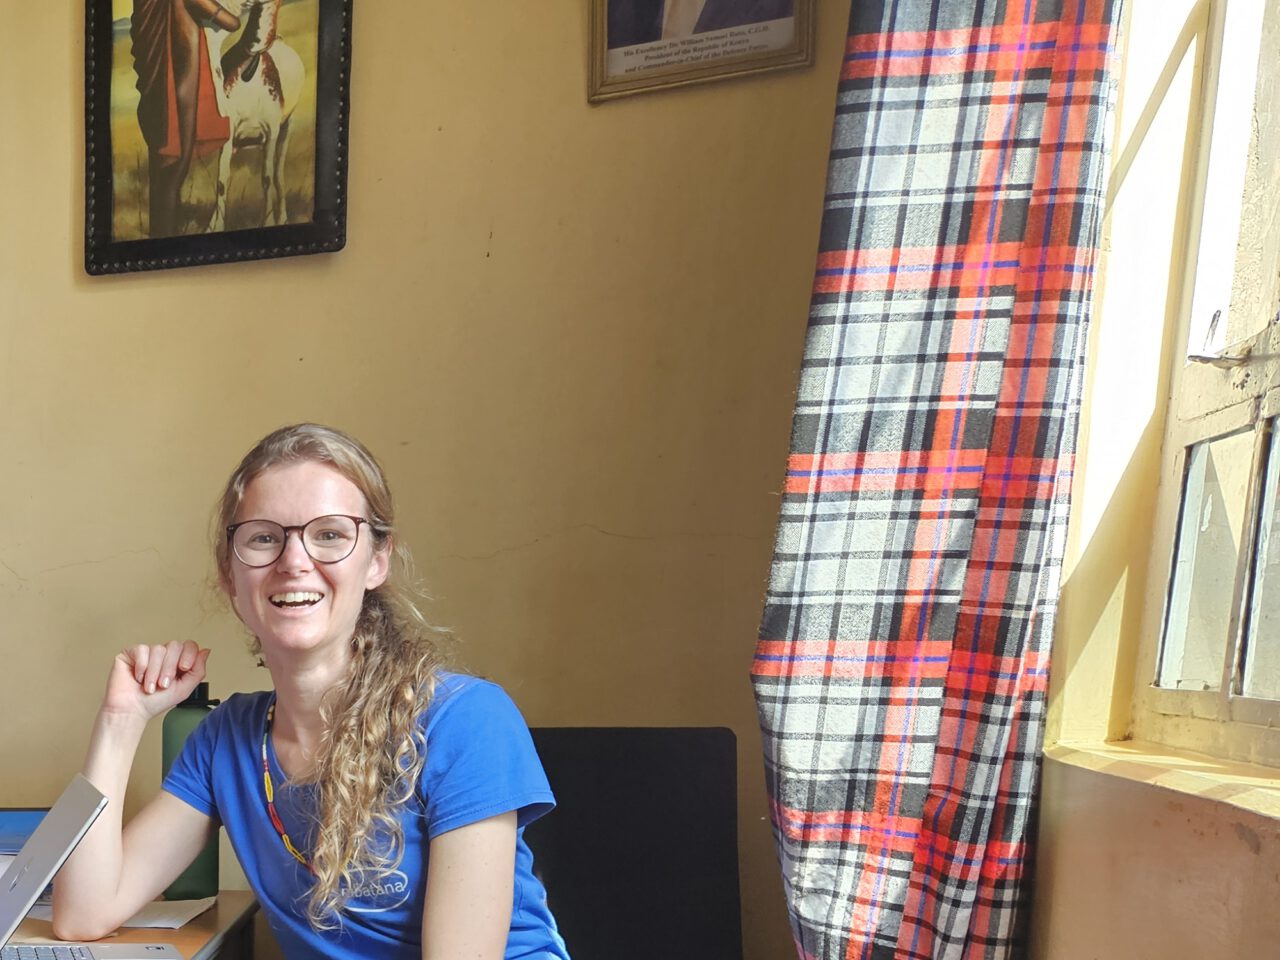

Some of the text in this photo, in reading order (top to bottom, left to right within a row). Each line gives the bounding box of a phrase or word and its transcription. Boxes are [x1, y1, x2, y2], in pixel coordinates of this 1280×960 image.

[680, 37, 704, 46] William
[705, 34, 728, 42] Samuel
[644, 51, 672, 62] President
[693, 43, 722, 54] Republic
[729, 37, 750, 47] Kenya
